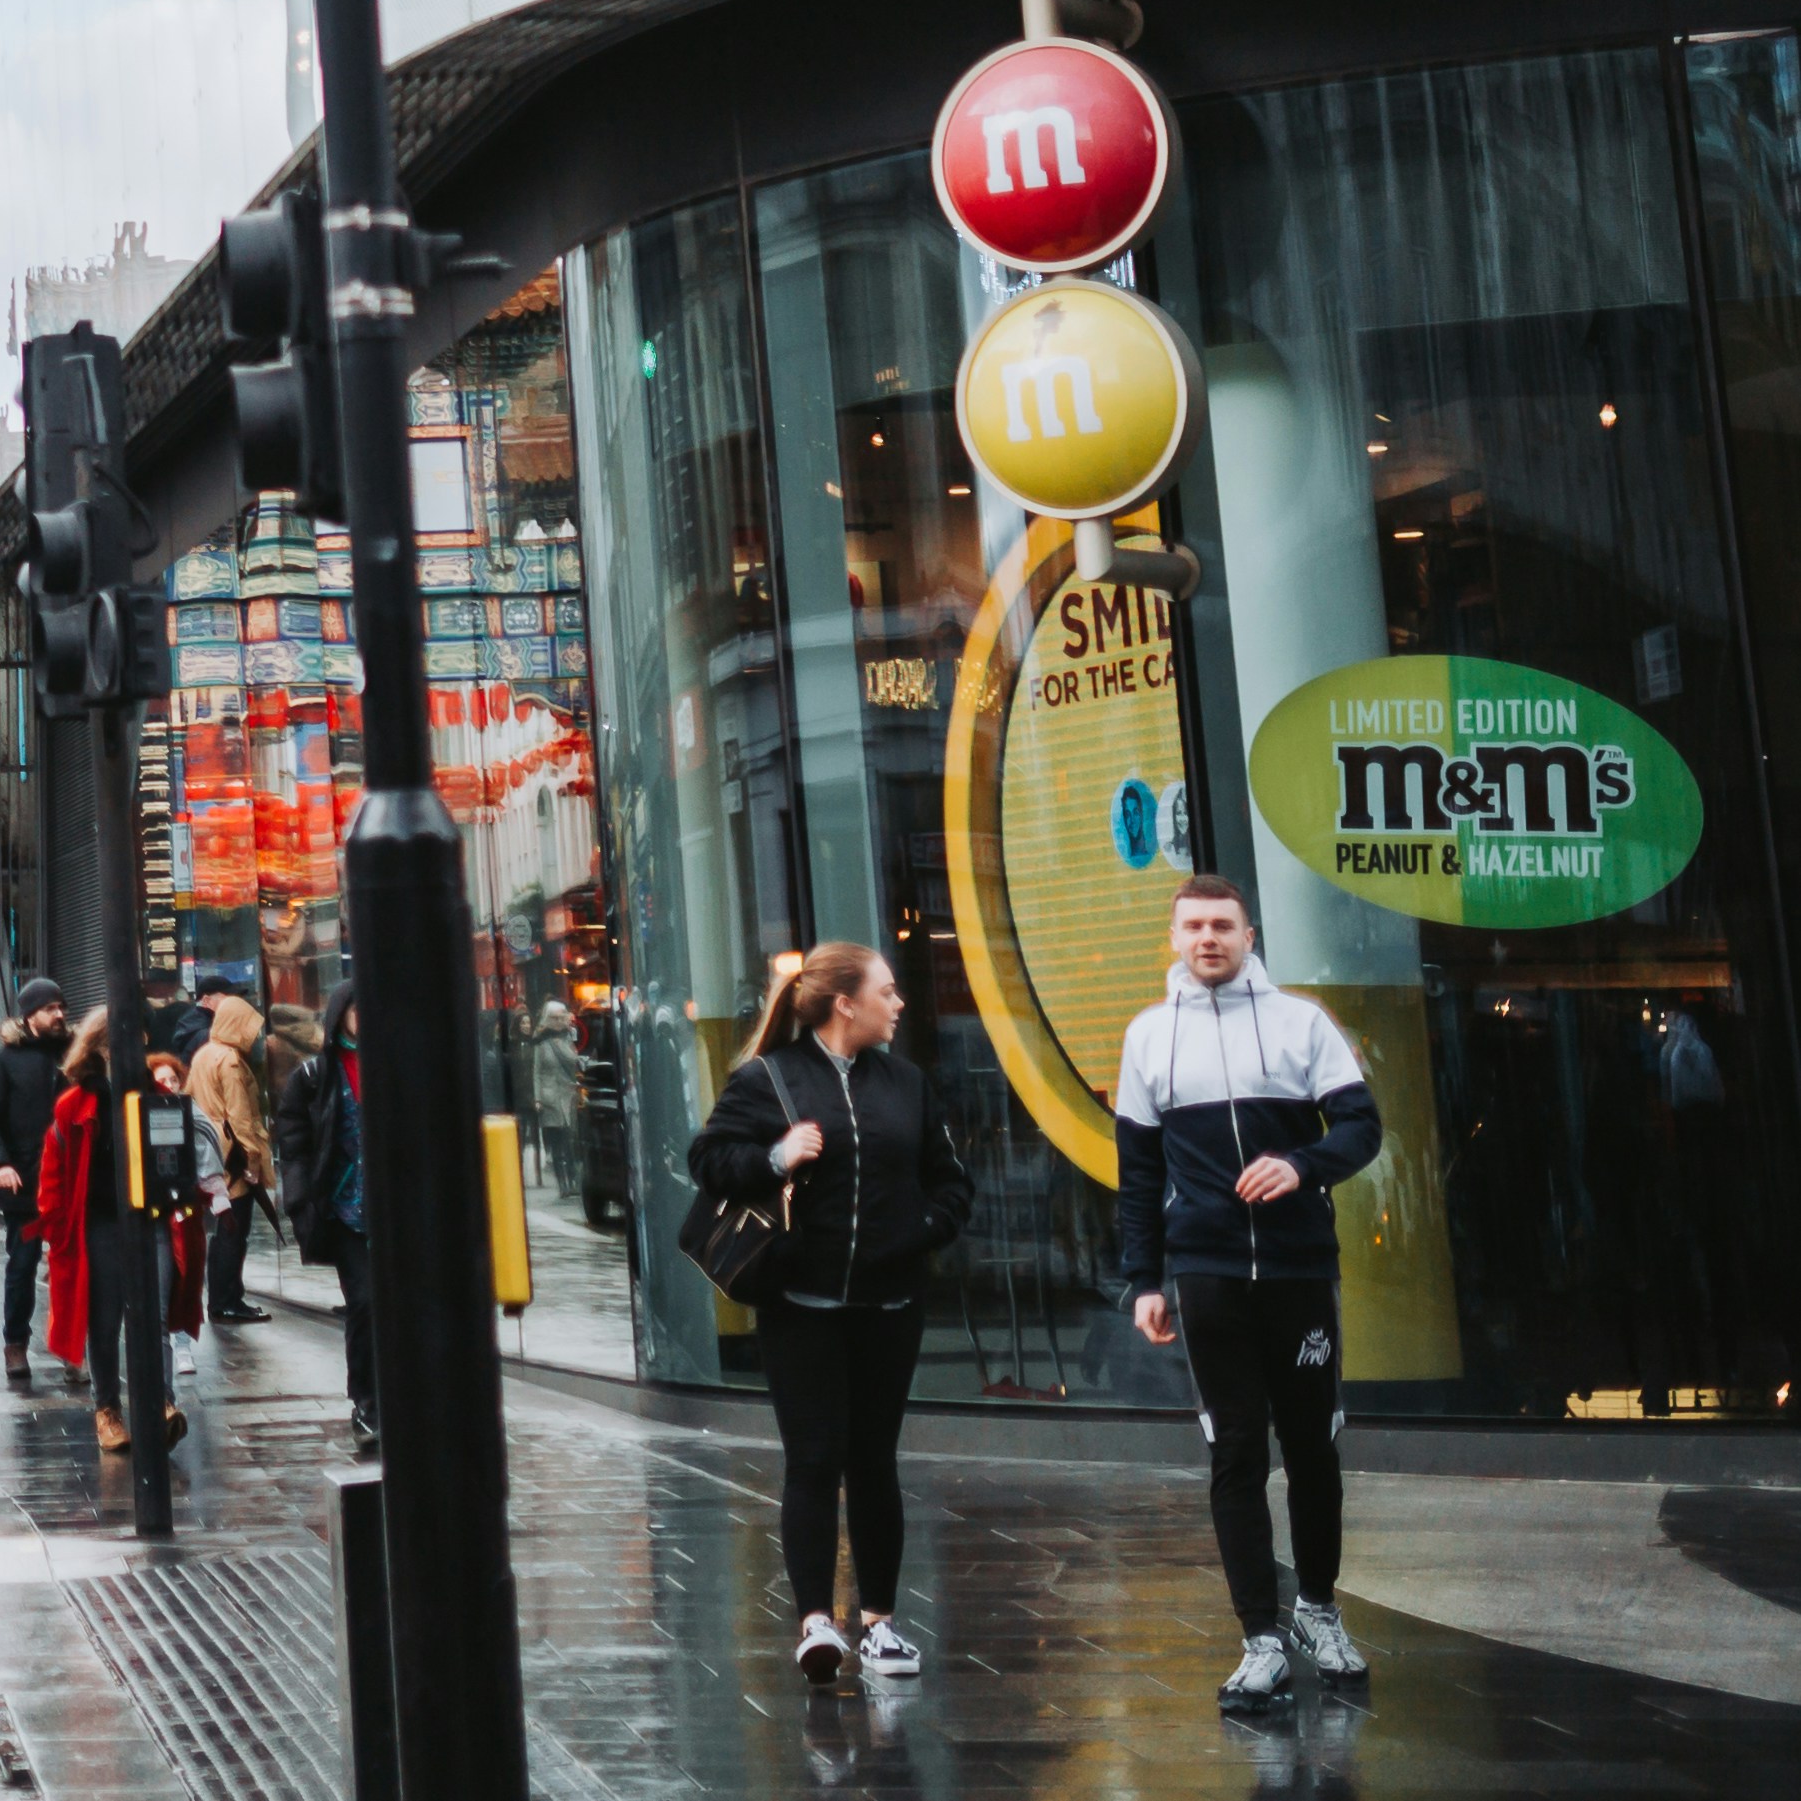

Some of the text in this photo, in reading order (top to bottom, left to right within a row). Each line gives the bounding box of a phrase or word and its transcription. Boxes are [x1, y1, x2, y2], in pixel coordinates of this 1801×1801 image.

[983, 105, 1086, 194] m
[1001, 353, 1104, 444] m
[1029, 671, 1080, 711] FOR
[1085, 659, 1136, 699] THE
[1329, 699, 1578, 735] LIMITED EDITION
[1335, 842, 1605, 878] PEANUT & HAZELNUT
